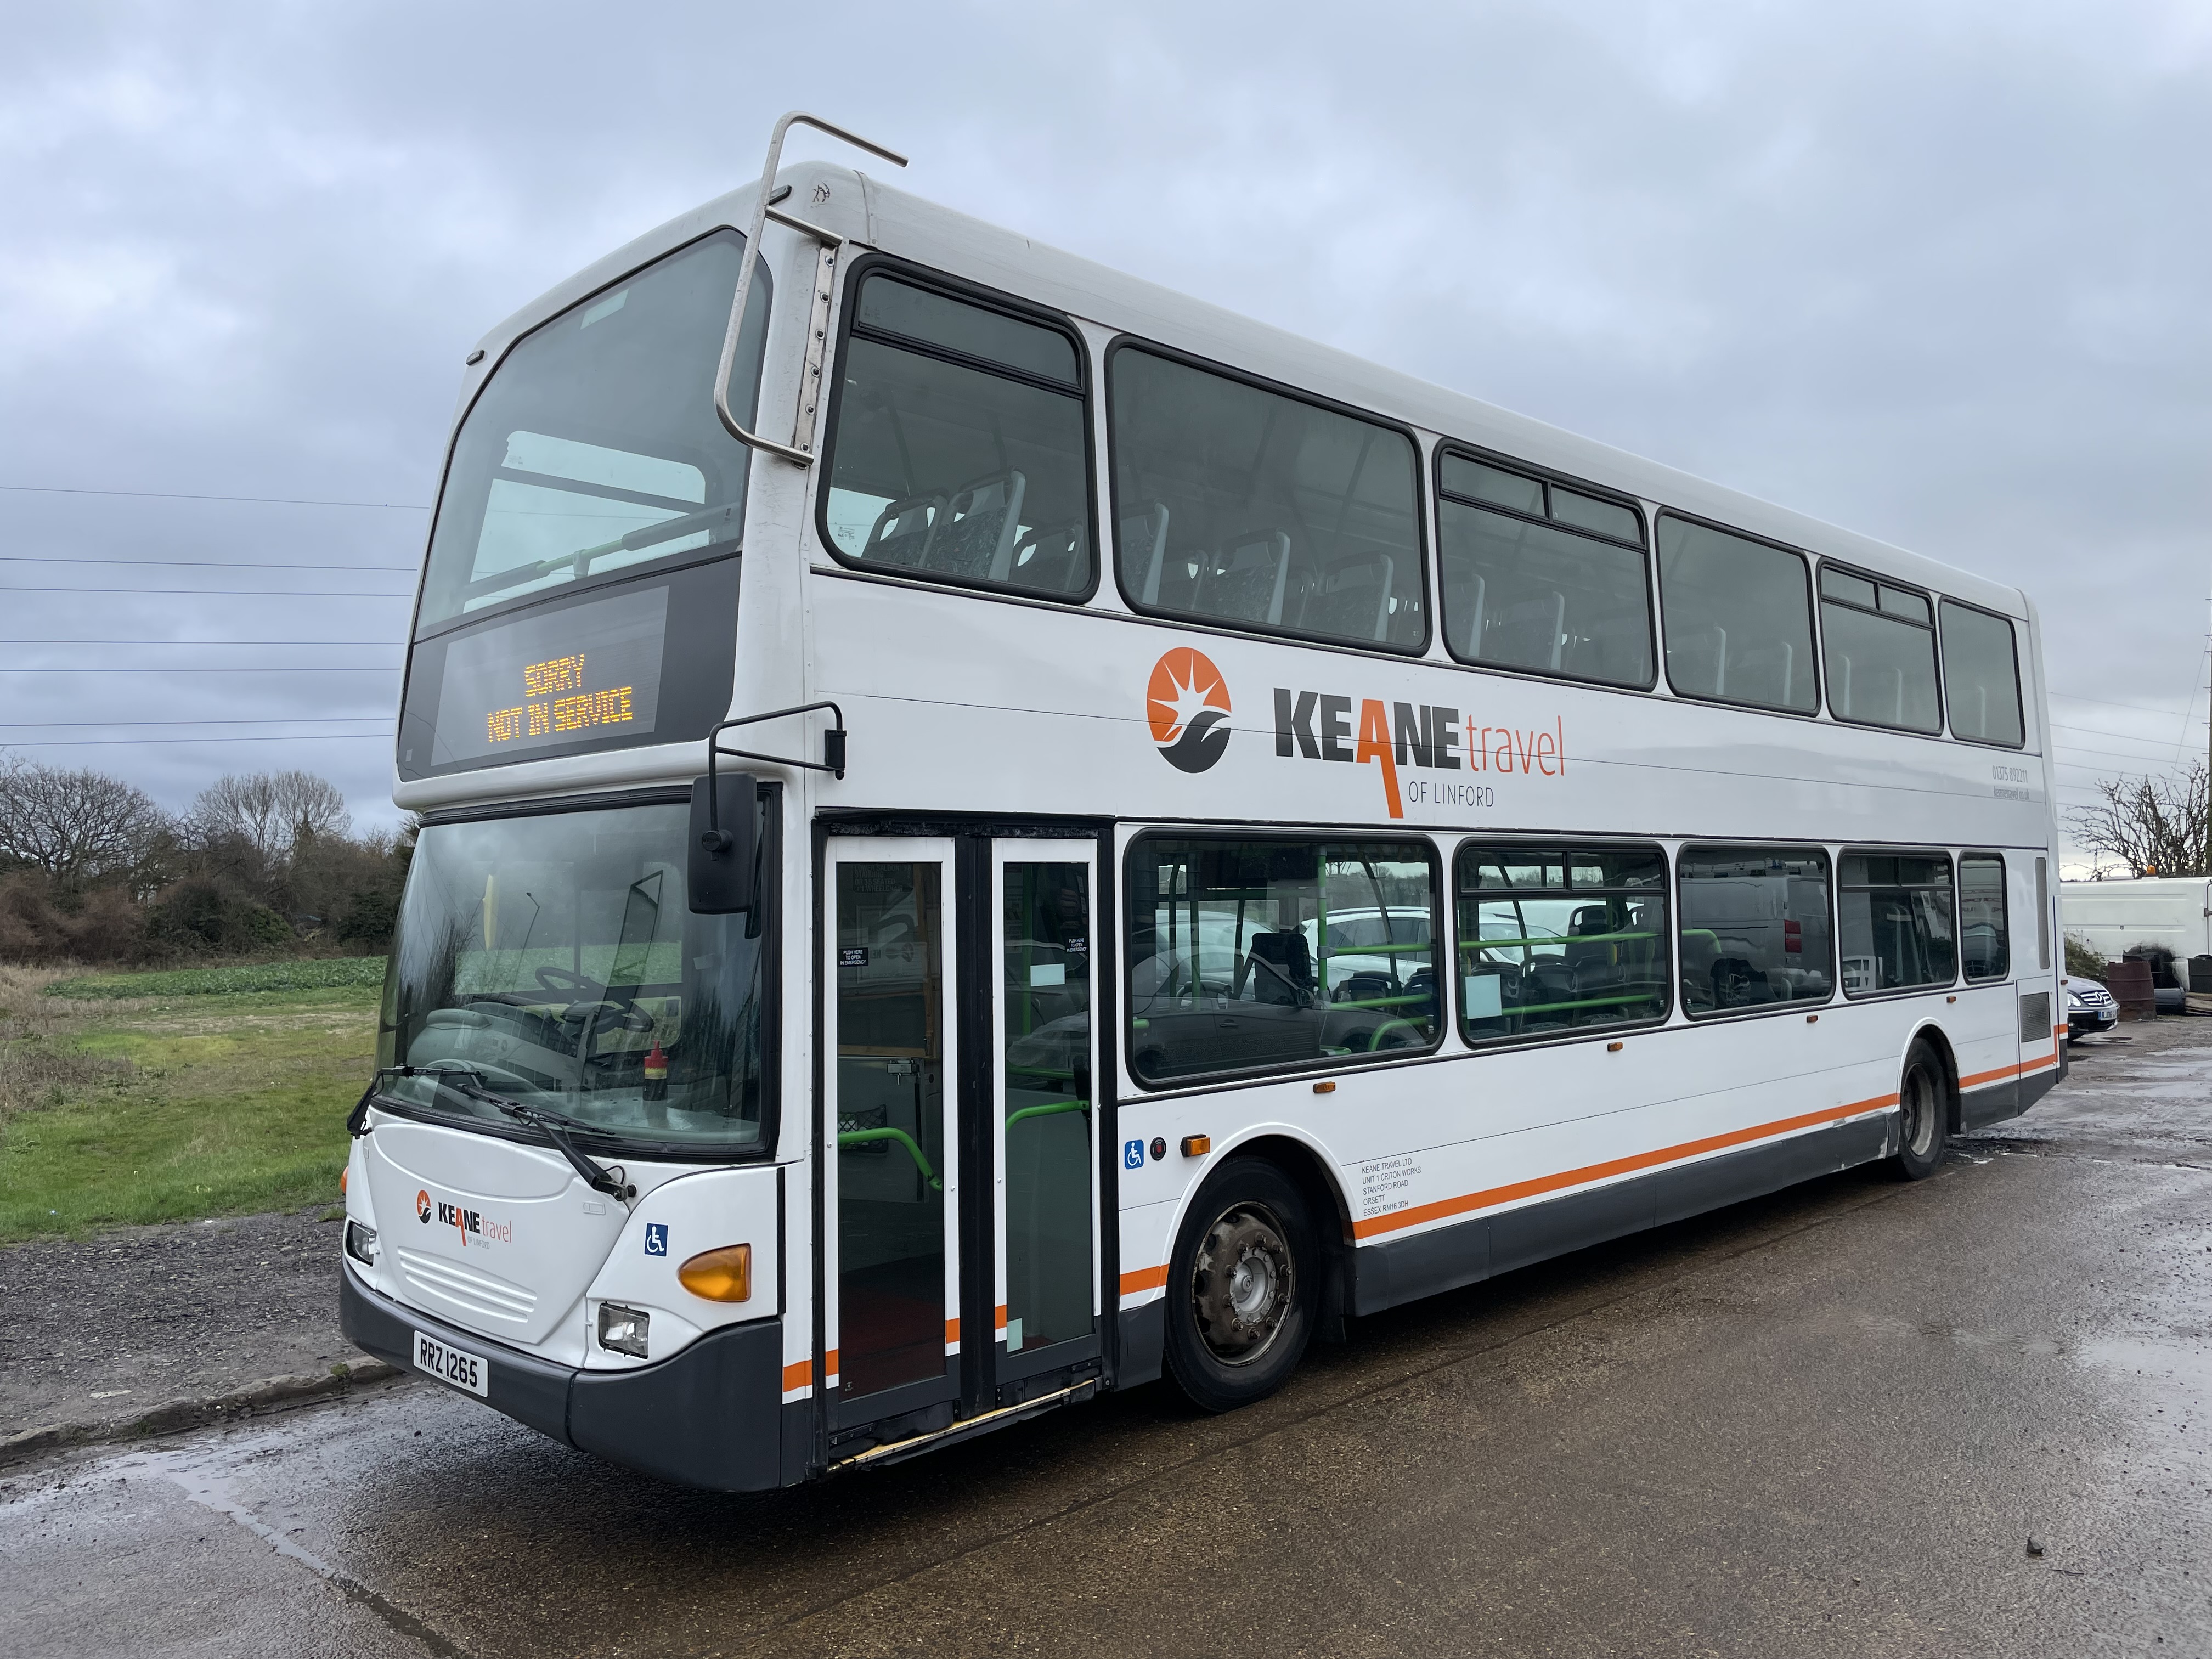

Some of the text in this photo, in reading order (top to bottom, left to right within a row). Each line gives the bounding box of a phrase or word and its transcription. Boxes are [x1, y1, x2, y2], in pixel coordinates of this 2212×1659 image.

[524, 653, 585, 697] SORRY
[488, 686, 633, 742] NOT IN SERVICE
[1273, 687, 1565, 819] KEANE travel
[1992, 765, 2028, 783] 01375 892211
[1409, 781, 1494, 808] OF LINFORD
[1362, 1158, 1412, 1174] KEANE TRAVEL LTD
[1362, 1175, 1375, 1184] UNIT
[1380, 1171, 1401, 1181] CRITON
[1402, 1166, 1421, 1177] WORKS
[1363, 1180, 1408, 1195] STANFORD ROAD
[1363, 1194, 1385, 1205] ORSETT
[1363, 1200, 1409, 1216] ESSEX RM16 3DH
[438, 1201, 512, 1246] KEANE travel
[467, 1235, 490, 1250] OF LINFORD
[420, 1338, 477, 1388] RRZ 1265
